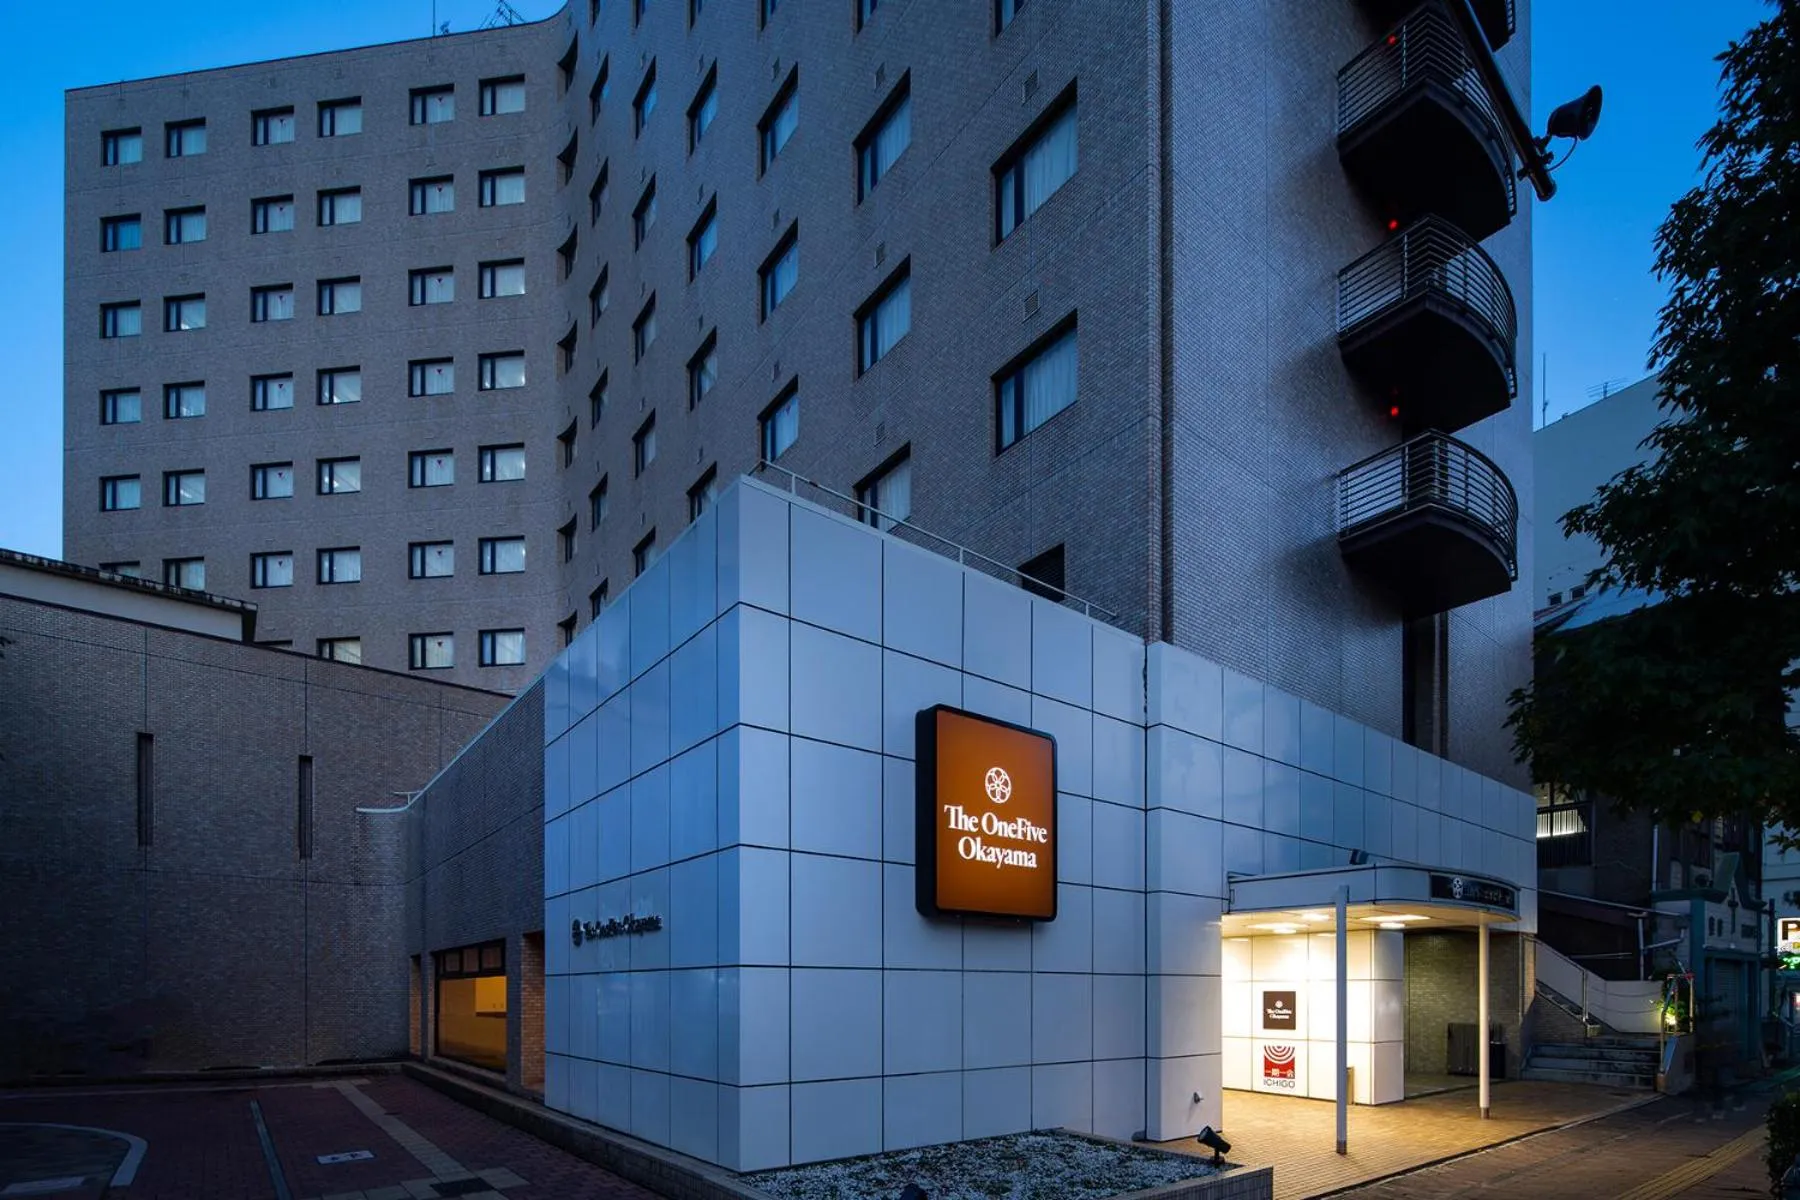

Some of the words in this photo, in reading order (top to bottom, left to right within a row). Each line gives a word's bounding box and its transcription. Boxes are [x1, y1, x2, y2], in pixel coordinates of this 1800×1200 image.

[944, 805, 979, 832] The
[981, 812, 1048, 843] OneFive
[958, 836, 1037, 868] Okayama
[1263, 1079, 1295, 1089] ICHIGO
